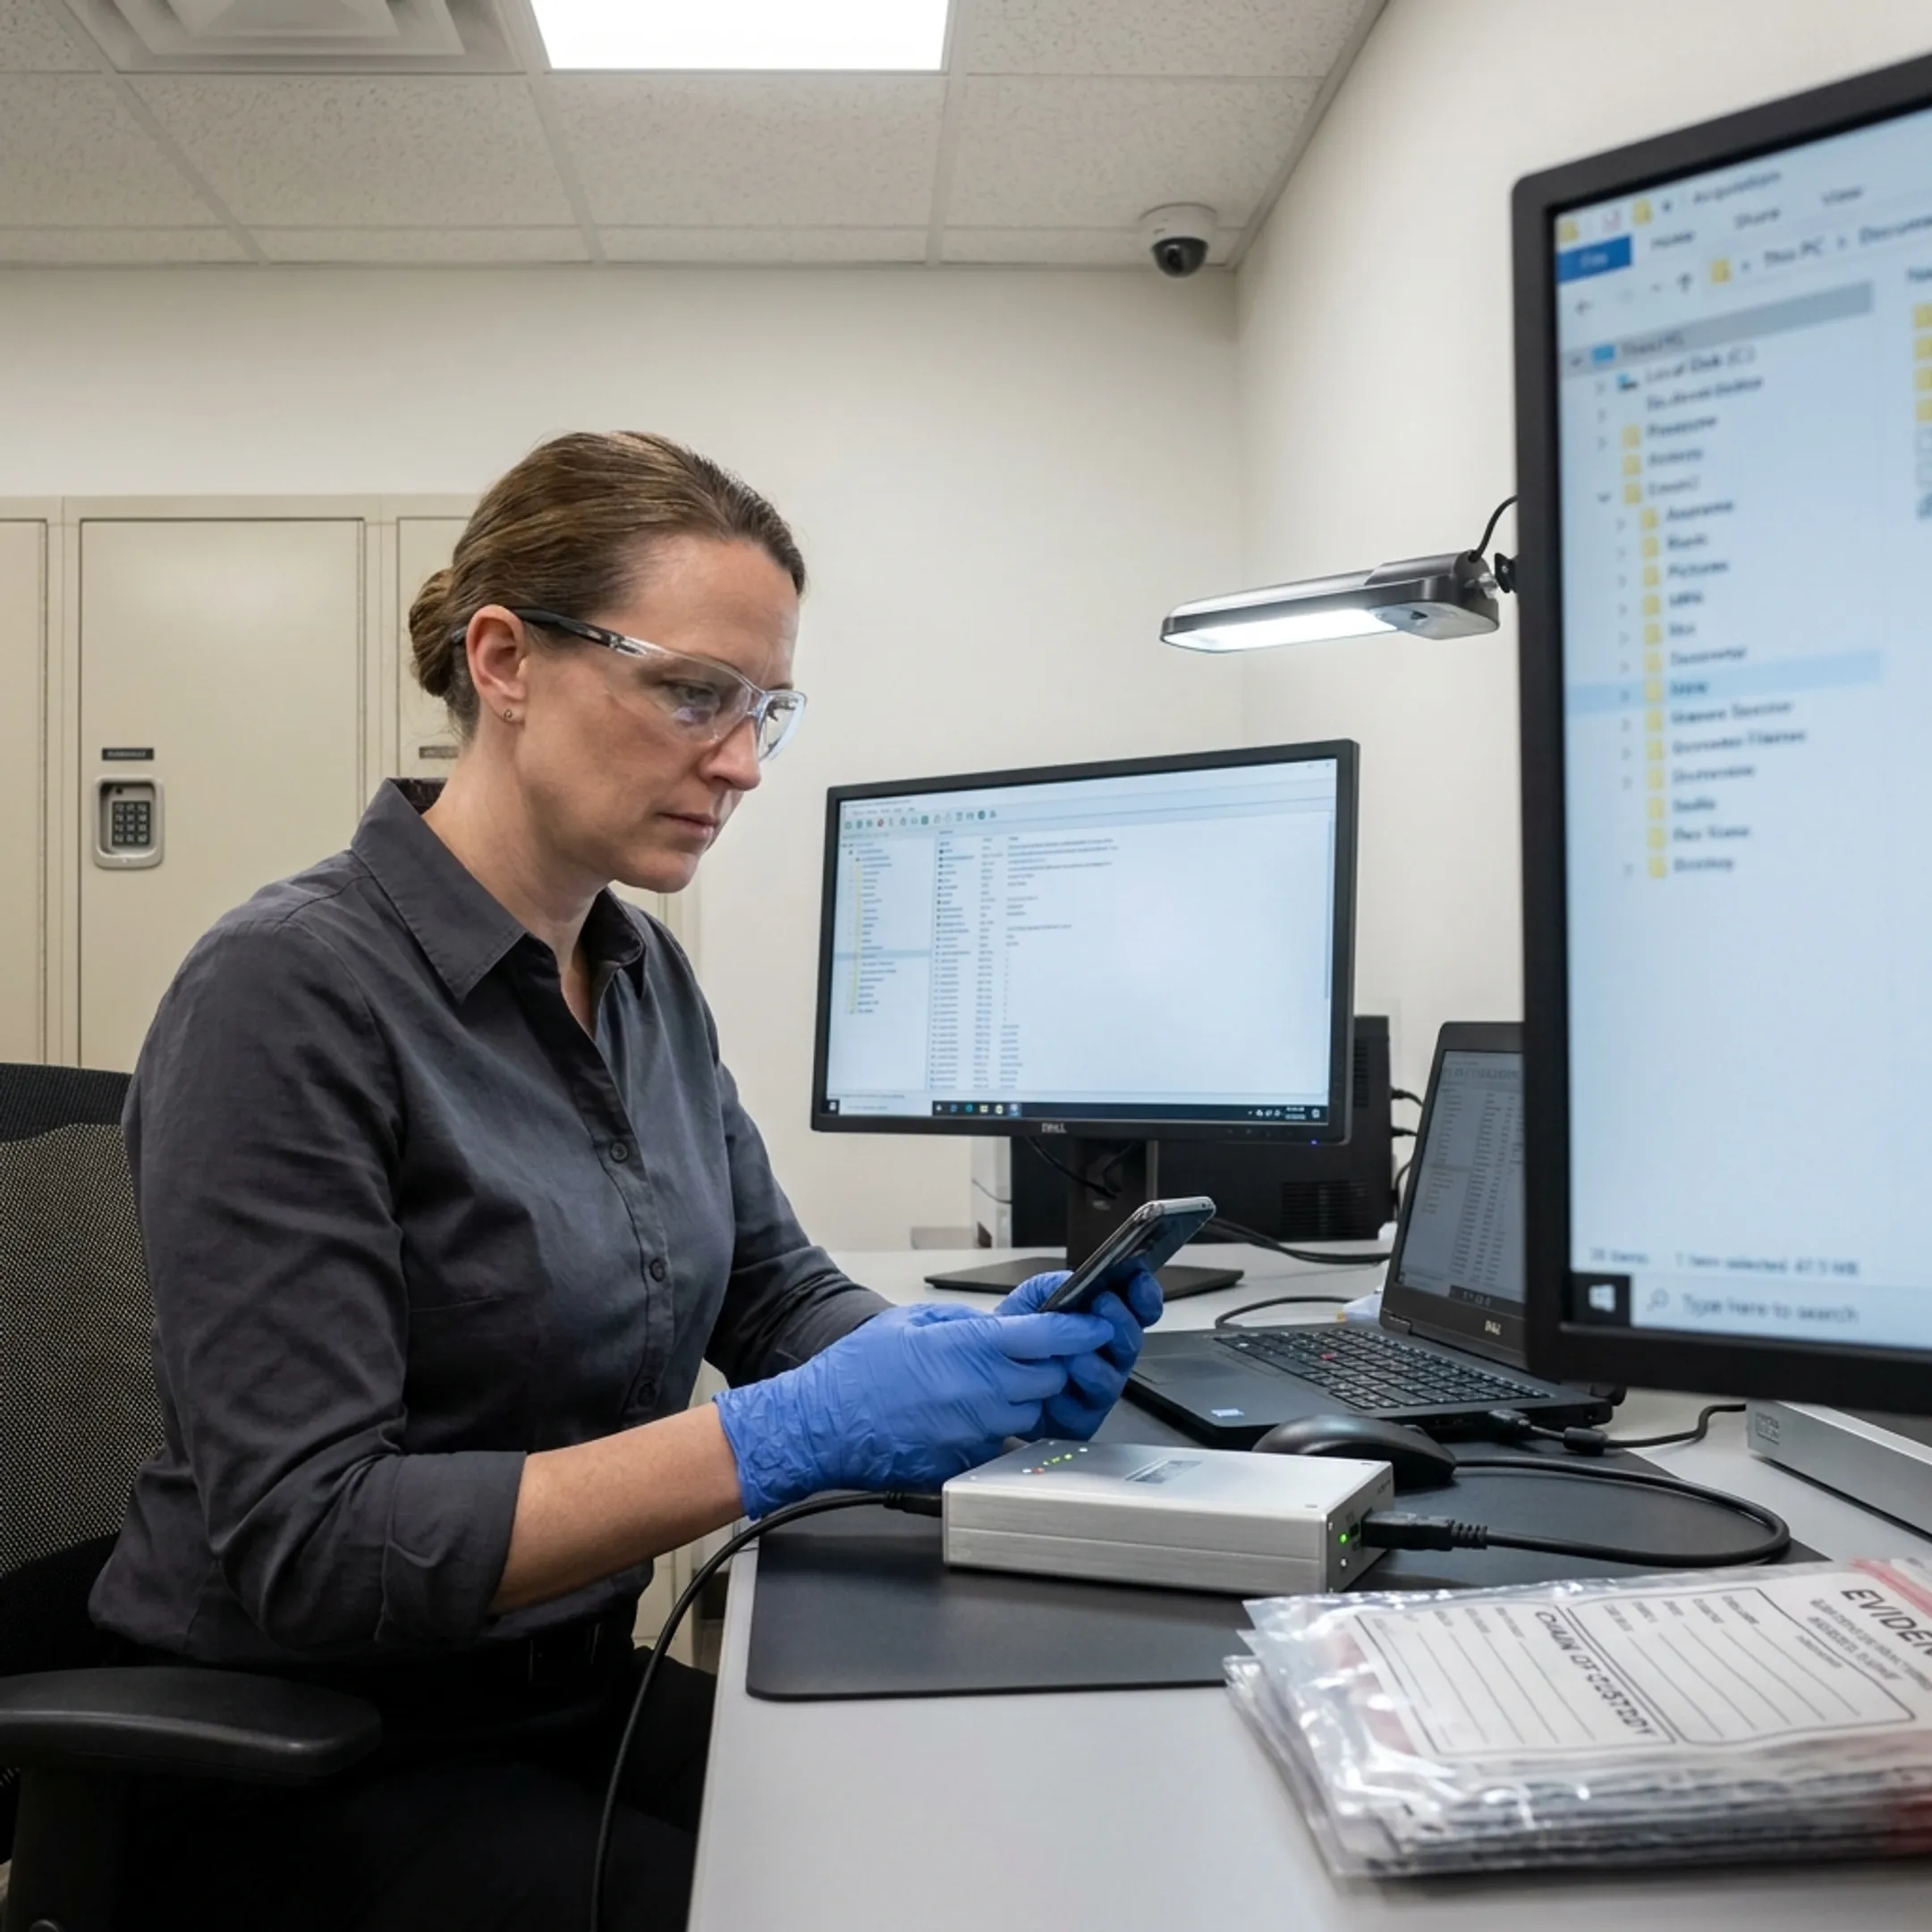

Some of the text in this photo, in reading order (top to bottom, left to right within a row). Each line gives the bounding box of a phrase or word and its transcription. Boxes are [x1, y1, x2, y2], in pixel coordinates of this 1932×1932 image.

[1682, 1294, 1722, 1318] Type
[1726, 1296, 1767, 1317] here
[1796, 1304, 1859, 1324] search
